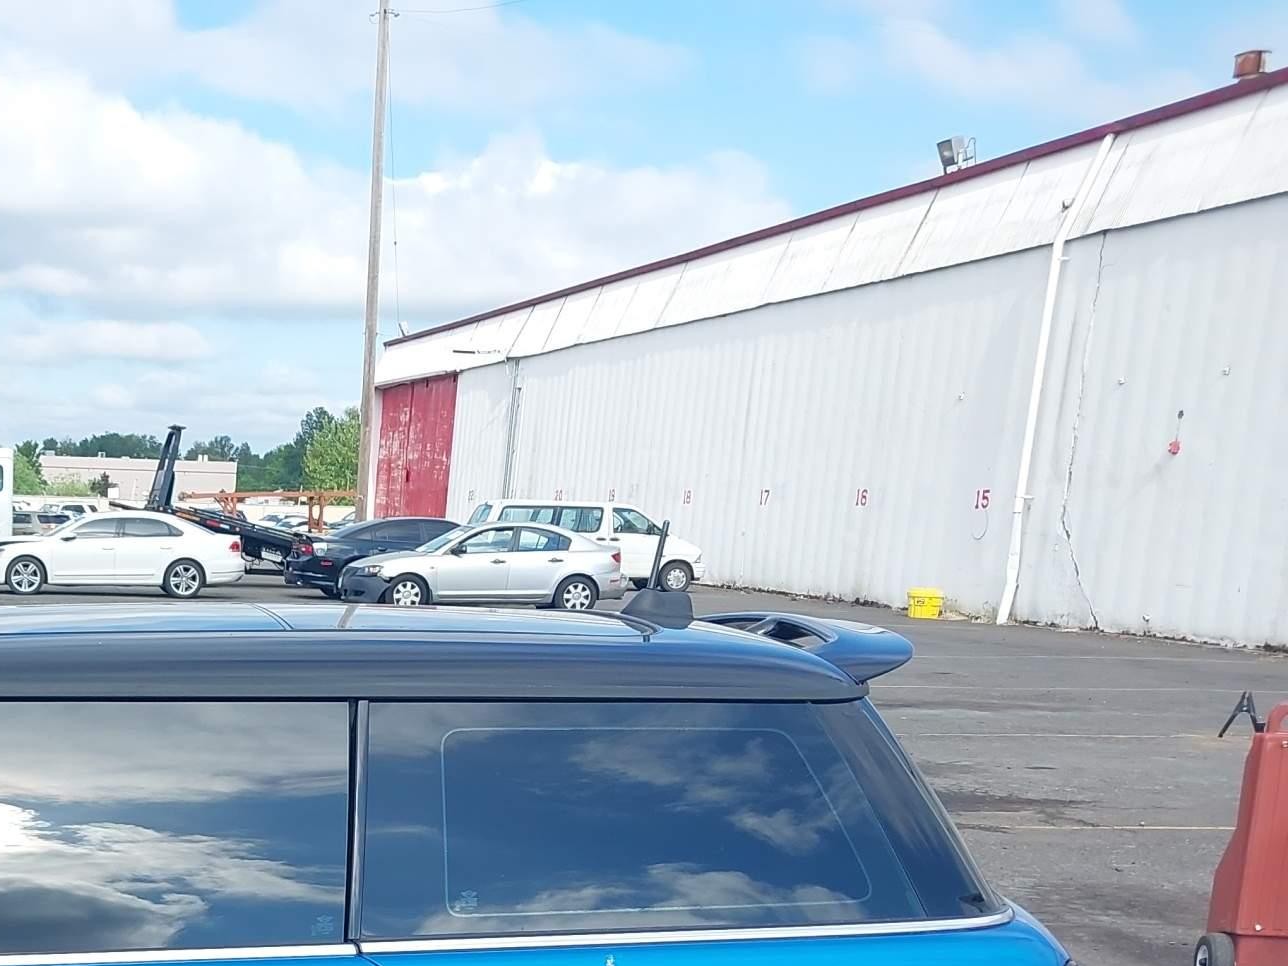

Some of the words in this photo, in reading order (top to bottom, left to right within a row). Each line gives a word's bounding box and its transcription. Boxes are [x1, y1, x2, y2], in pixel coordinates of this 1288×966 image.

[682, 489, 692, 504] 18
[758, 489, 770, 506] 17
[855, 489, 868, 506] 16
[974, 489, 991, 509] 15
